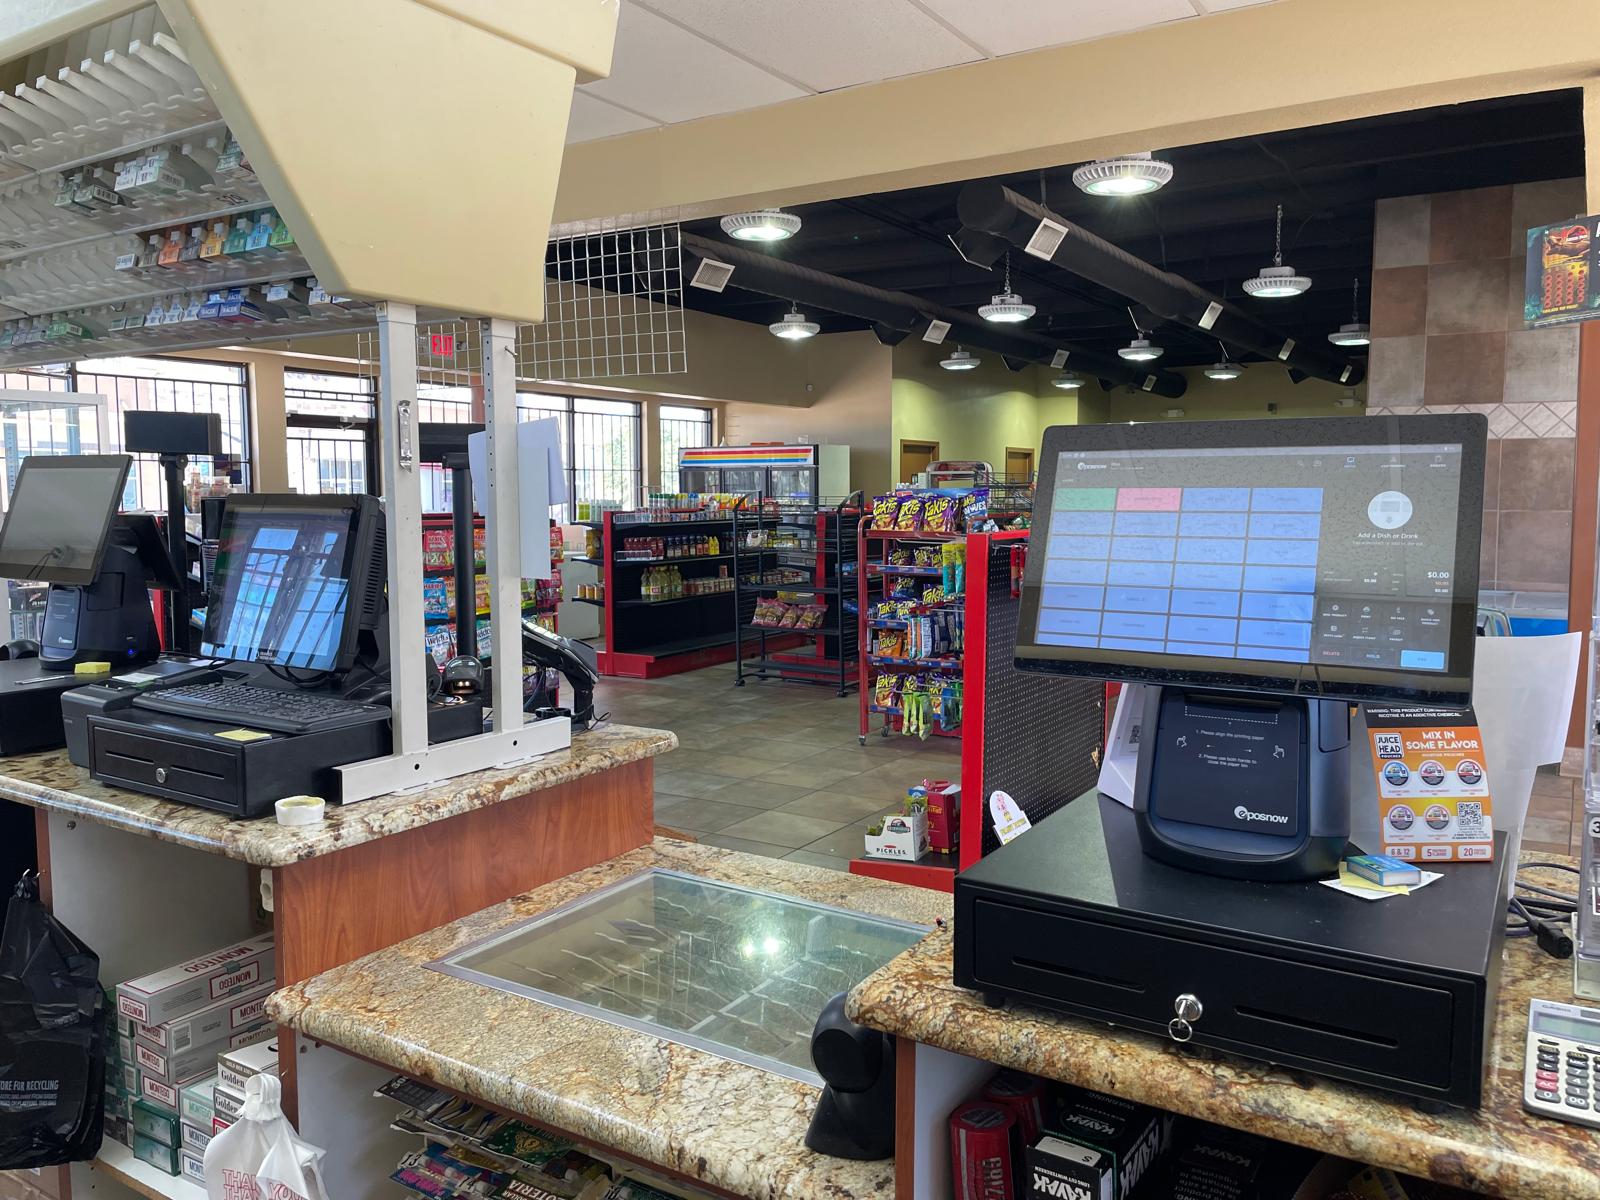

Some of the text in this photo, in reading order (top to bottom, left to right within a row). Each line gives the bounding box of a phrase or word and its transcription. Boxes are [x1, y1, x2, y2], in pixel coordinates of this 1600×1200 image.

[924, 498, 949, 514] Takis
[1377, 736, 1399, 744] JUICE
[1422, 731, 1456, 739] MIX IN
[1406, 740, 1479, 750] SOME FLAVOR
[1233, 805, 1289, 824] eposnow
[876, 847, 906, 855] PICKLES
[1427, 848, 1432, 857] 5
[1463, 848, 1473, 856] 20
[184, 946, 254, 975] MONTEGO
[219, 970, 251, 990] MONTEGO
[122, 1001, 144, 1019] MONTEGO
[239, 1000, 265, 1018] MONTE
[141, 1048, 160, 1067] MONTEGO
[13, 1080, 25, 1091] FOR
[26, 1080, 59, 1091] RECYCLING
[221, 1069, 245, 1088] Golden
[149, 1080, 170, 1099] MONTEGO
[1569, 1096, 1586, 1105] 00
[1066, 1114, 1115, 1134] KAYAK
[401, 1154, 422, 1166] 13
[1120, 1123, 1160, 1200] KAYAK
[458, 1177, 476, 1190] 14
[1034, 1165, 1090, 1187] LONG CUT WINTERGREEN
[1033, 1173, 1091, 1200] KAYAK
